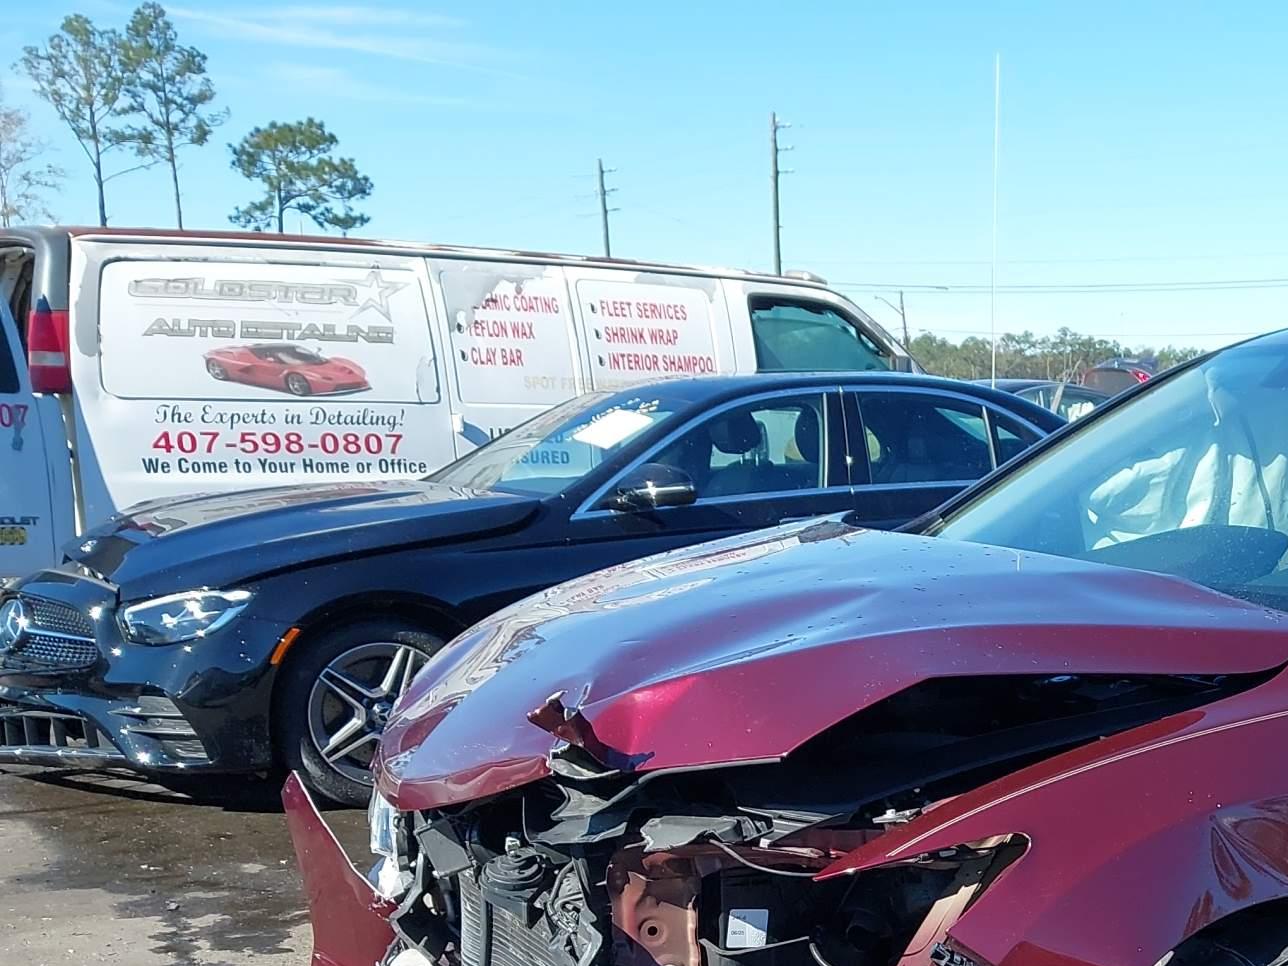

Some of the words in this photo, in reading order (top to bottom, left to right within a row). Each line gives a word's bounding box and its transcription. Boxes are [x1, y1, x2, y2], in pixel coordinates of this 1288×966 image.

[513, 295, 559, 314] COATING
[599, 301, 632, 318] FLEET
[635, 303, 688, 321] SERVICES
[142, 317, 236, 339] AUTO
[510, 322, 535, 339] WAX
[604, 326, 647, 345] SHRINK
[648, 328, 679, 346] WRAP
[471, 346, 497, 366] CLAY
[500, 348, 524, 367] BAR
[607, 352, 660, 371] INTERIOR
[661, 354, 714, 374] SHAMPOO
[154, 404, 194, 425] The
[200, 405, 276, 430] Experts
[284, 408, 303, 425] in
[309, 407, 405, 432] Detailing!
[152, 431, 403, 455] 407-598-0807
[141, 458, 171, 474] We
[177, 459, 229, 474] Come
[234, 459, 251, 474] to
[257, 459, 296, 474] Your
[302, 459, 350, 474] Home
[356, 462, 373, 474] or
[378, 458, 428, 474] Office
